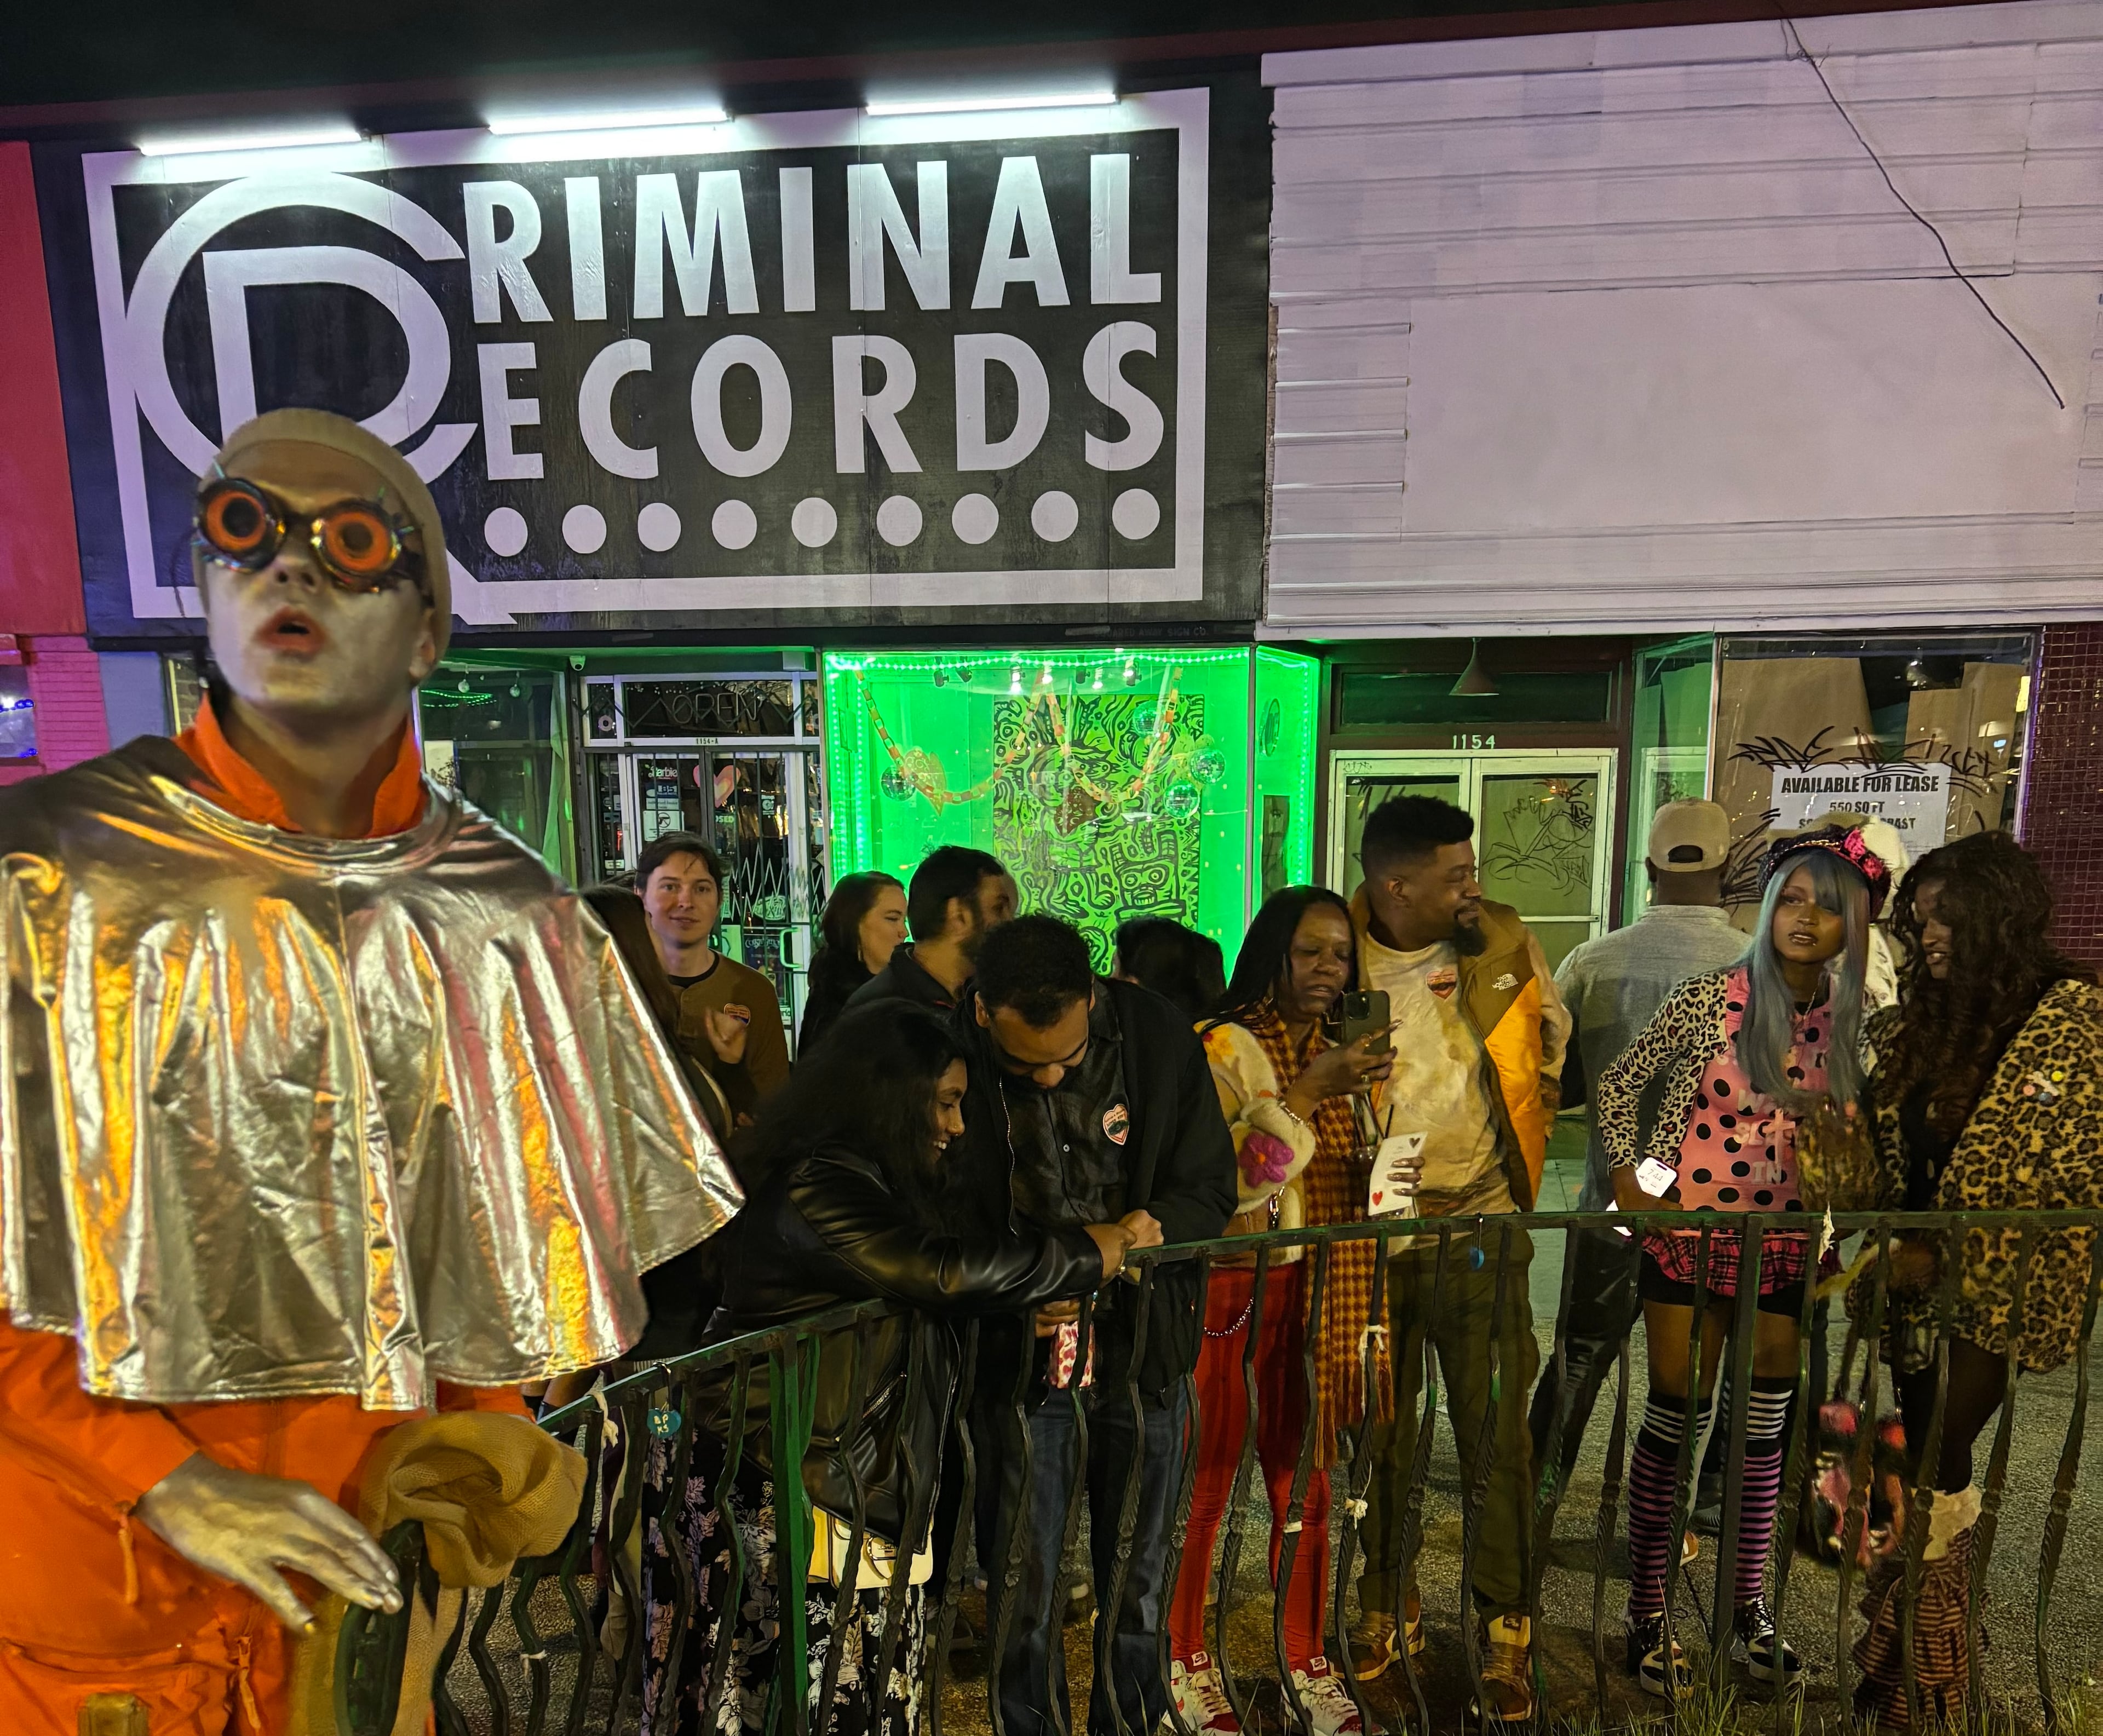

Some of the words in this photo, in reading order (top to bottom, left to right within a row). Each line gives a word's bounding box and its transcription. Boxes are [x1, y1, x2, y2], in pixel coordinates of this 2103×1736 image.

[673, 690, 757, 723] OPEN
[1453, 734, 1495, 749] 1154
[1781, 777, 1860, 793] AVAILABLE
[1863, 776, 1892, 792] FOR
[1894, 775, 1939, 792] LEASE
[1829, 802, 1852, 813] 550
[1855, 801, 1870, 814] SQ
